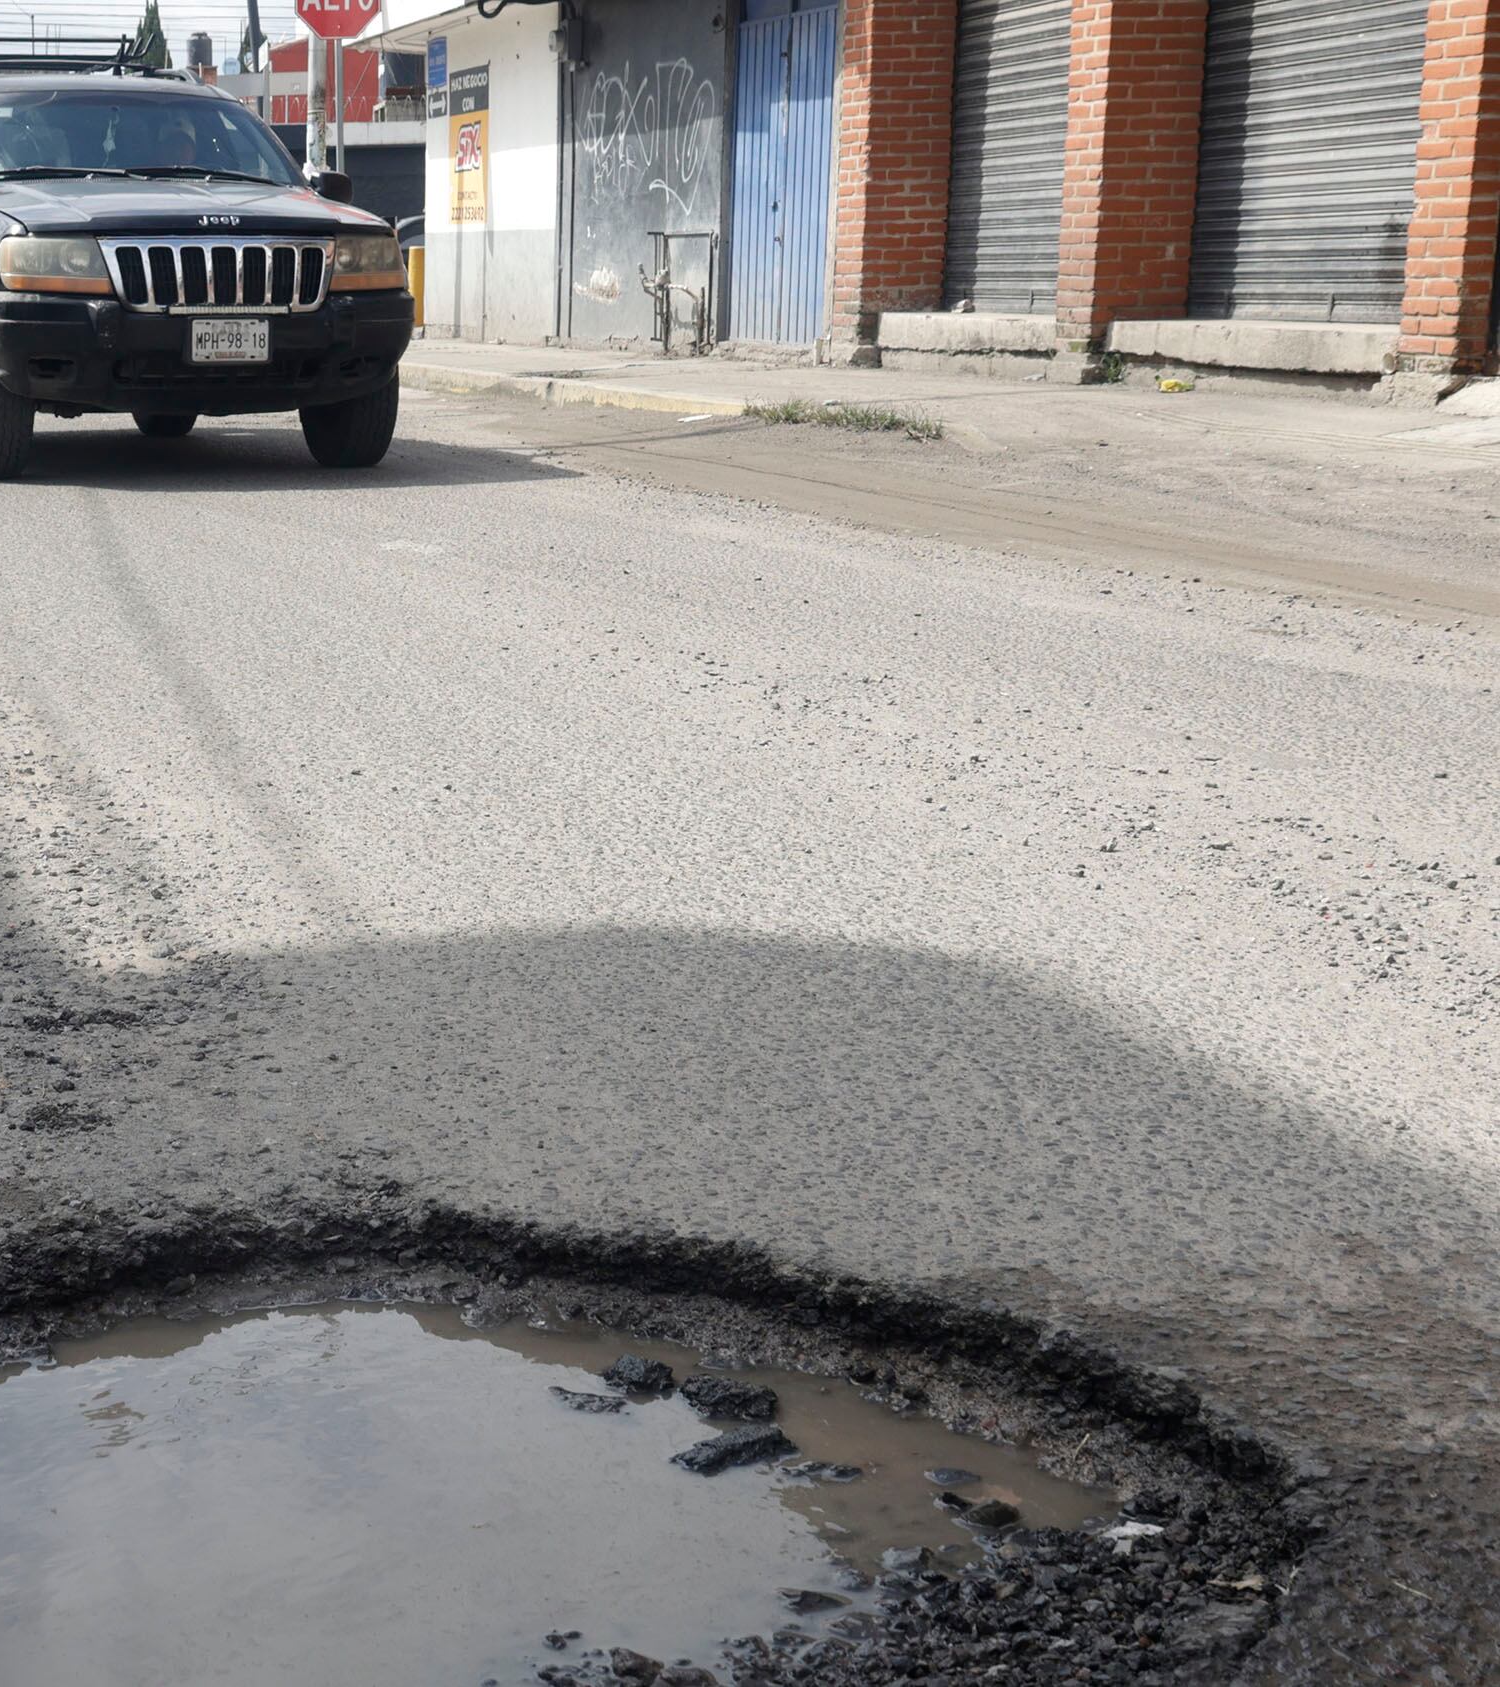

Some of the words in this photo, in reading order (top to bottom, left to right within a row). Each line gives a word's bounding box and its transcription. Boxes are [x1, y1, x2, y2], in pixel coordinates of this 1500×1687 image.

[451, 77, 462, 92] HAZ
[463, 72, 488, 89] NEGOCIO
[462, 96, 475, 112] CON
[455, 120, 481, 172] SIX
[199, 215, 240, 226] Jeep
[195, 332, 267, 350] MPH-98-18
